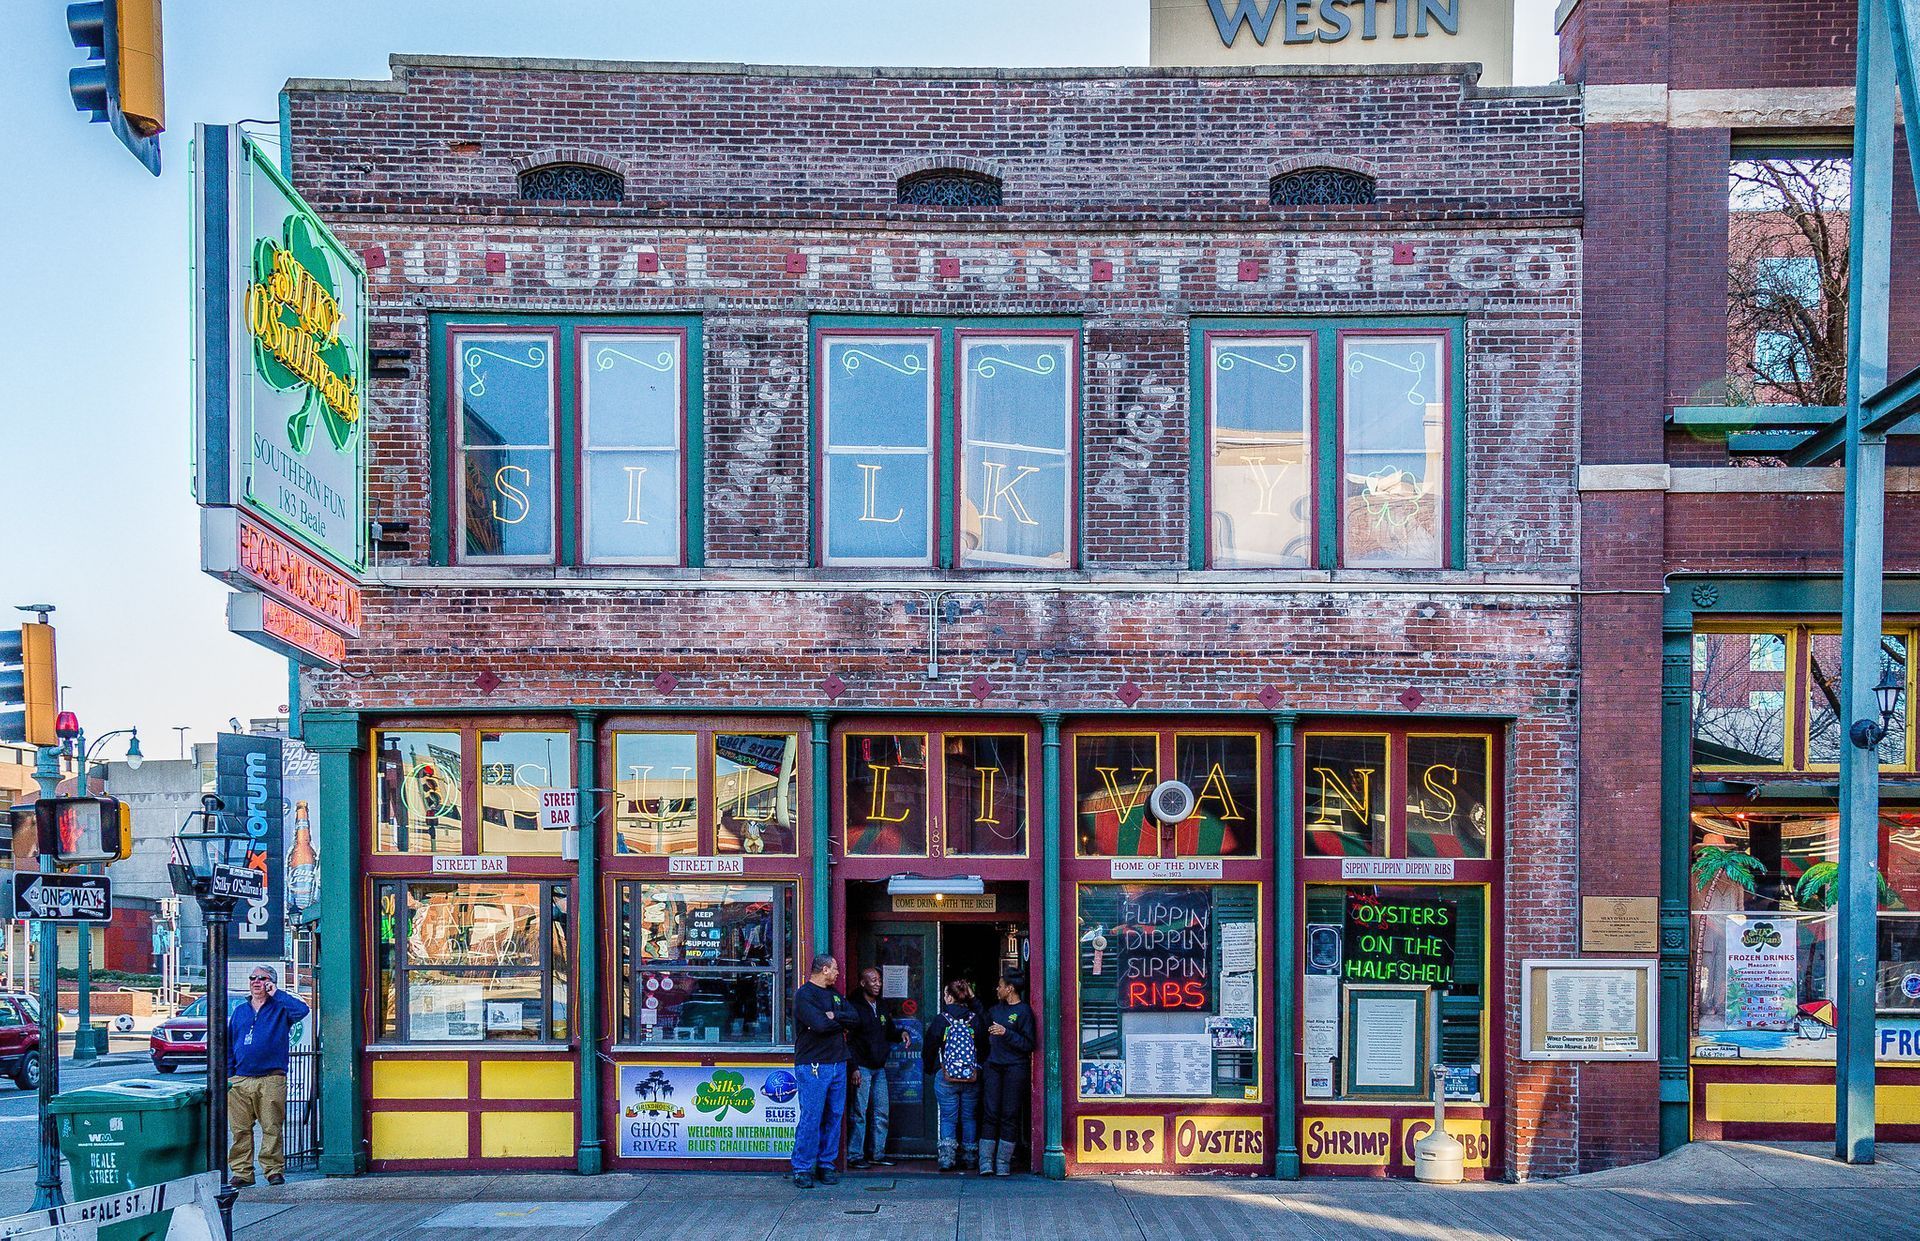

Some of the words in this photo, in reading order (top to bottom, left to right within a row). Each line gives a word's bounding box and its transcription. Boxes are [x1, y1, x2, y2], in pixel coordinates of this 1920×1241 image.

[1208, 0, 1460, 48] WESTIN
[267, 249, 347, 345] Silky
[254, 432, 321, 500] SOUTHERN
[323, 484, 346, 520] FUN
[279, 485, 296, 518] 183
[299, 499, 327, 538] Beale
[543, 792, 576, 807] STREET
[550, 809, 571, 824] BAR
[436, 859, 478, 871] STREET
[481, 859, 503, 871] BAR
[672, 859, 713, 871] STREET
[715, 859, 740, 872] BAR
[1113, 861, 1143, 871] HOME
[1147, 861, 1163, 871] OF
[1165, 861, 1187, 871] THE
[1189, 861, 1220, 871] DIVER
[1345, 862, 1371, 874] SIPPIN'
[1405, 863, 1432, 874] DIPPIN'
[1434, 863, 1452, 875] RIBS
[215, 875, 231, 894] Silky
[71, 888, 98, 907] WAY
[895, 898, 915, 908] COME
[917, 898, 938, 908] DRINK
[940, 898, 958, 909] WITH
[960, 899, 974, 909] THE
[976, 899, 994, 909] IRISH
[1359, 905, 1448, 925] OYSTERS
[1361, 935, 1393, 954] ON
[1404, 937, 1442, 956] THE
[1130, 982, 1205, 1008] RIBS
[706, 1080, 745, 1097] Silky
[636, 1102, 676, 1112] GRINDHOUSE
[691, 1095, 756, 1107] O'Sullivan's
[765, 1110, 796, 1118] BLUES
[630, 1122, 680, 1139] GHOST
[687, 1126, 733, 1139] WELCOMES
[736, 1126, 796, 1139] INTERNATIONA
[1083, 1118, 1156, 1153] RIBS
[1177, 1119, 1263, 1158] OYSTERS
[632, 1139, 677, 1152] RIVER
[688, 1140, 717, 1152] BLUES
[719, 1140, 770, 1152] CHALLENGE
[1306, 1120, 1389, 1159] SHRIMP
[90, 1152, 117, 1168] BEALE
[89, 1169, 119, 1184] STREET
[82, 1199, 121, 1223] BEALE
[126, 1194, 146, 1214] ST.
